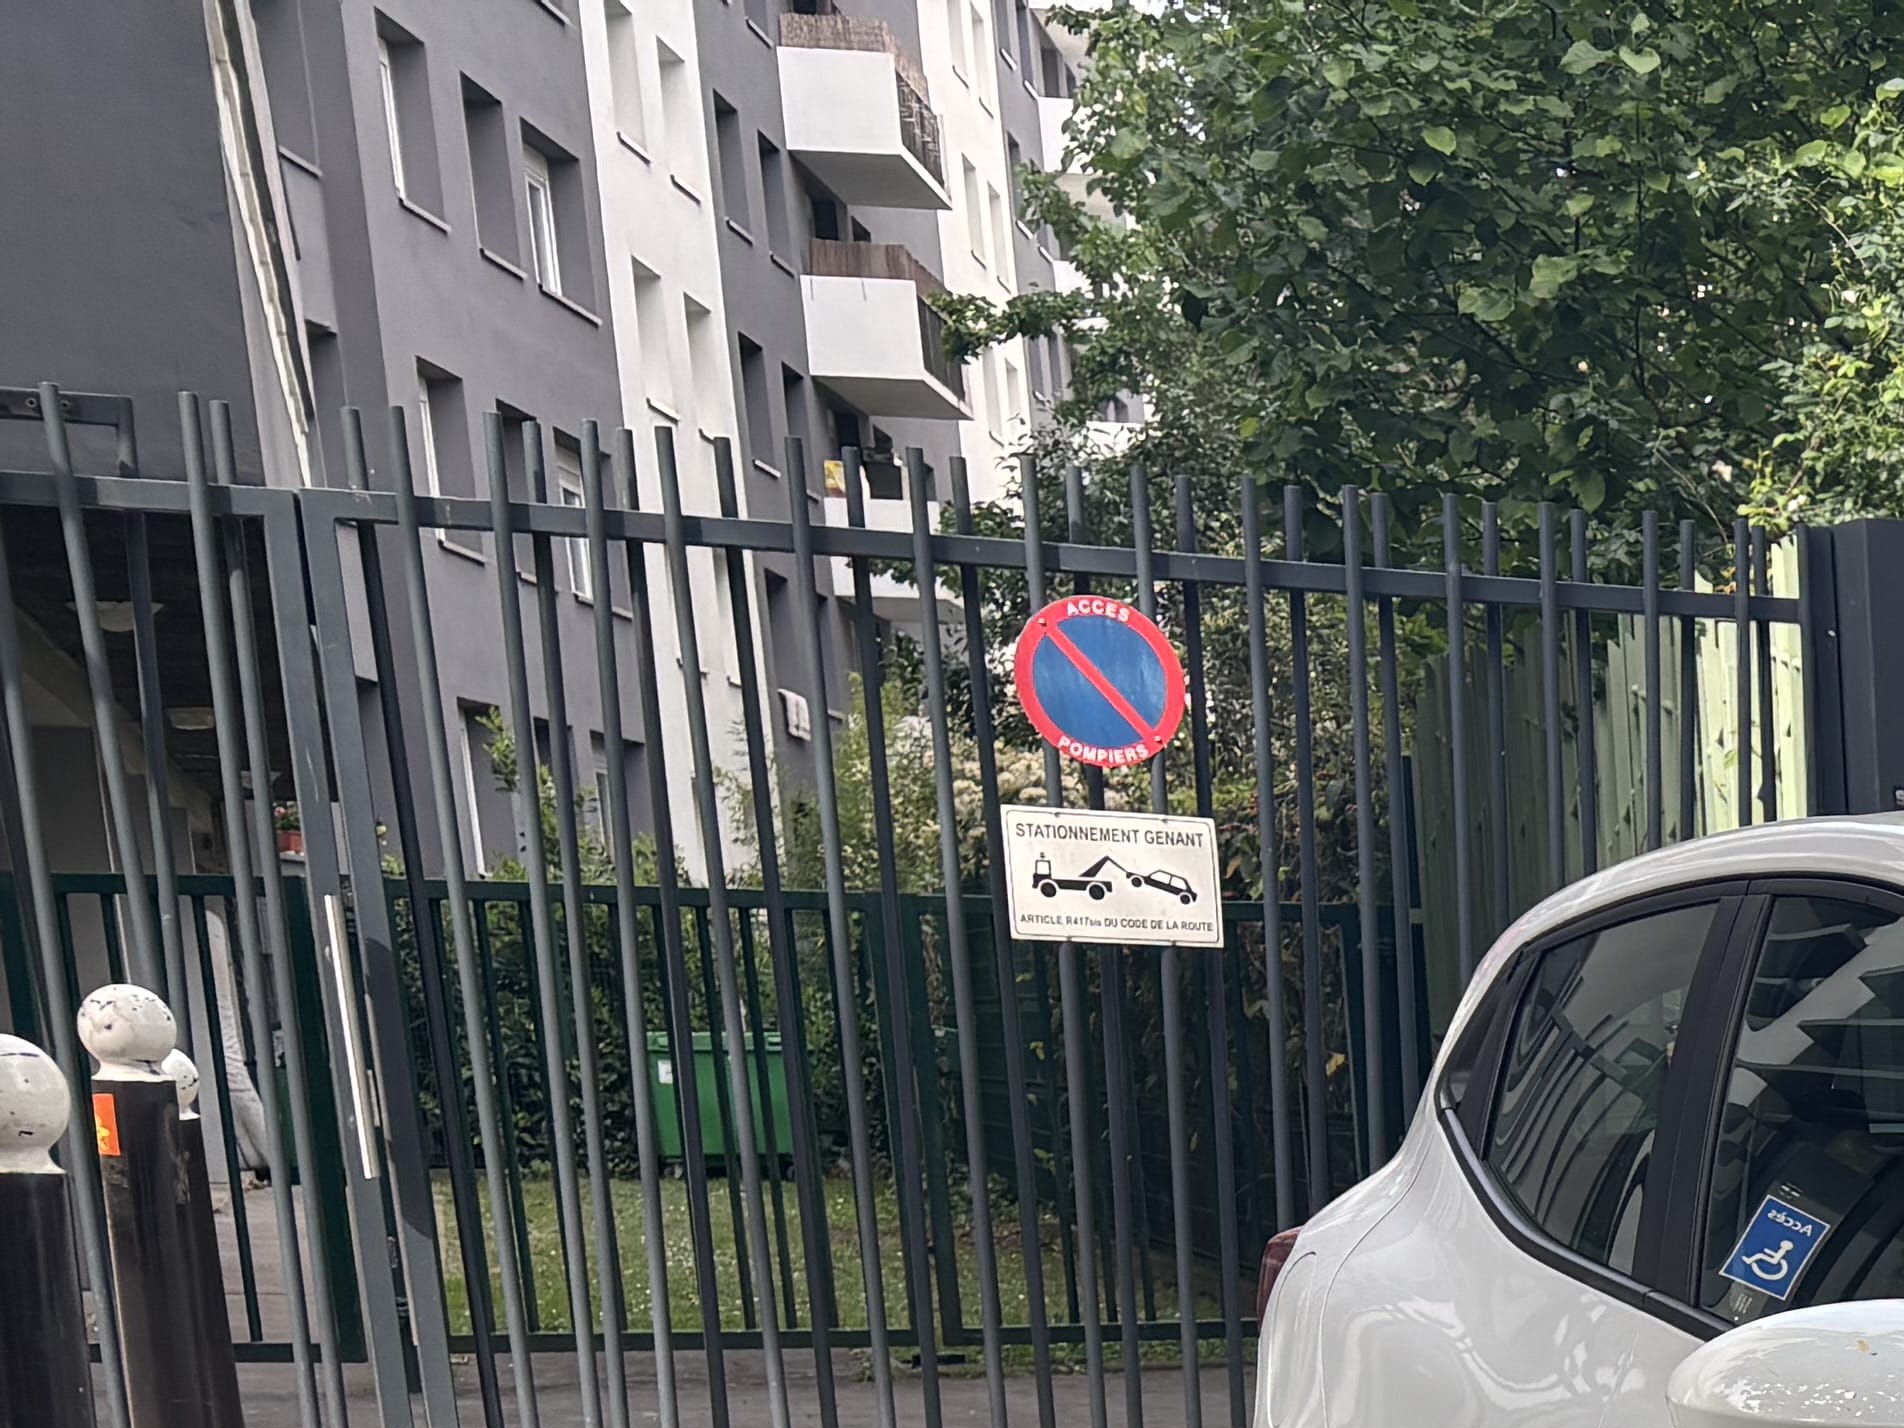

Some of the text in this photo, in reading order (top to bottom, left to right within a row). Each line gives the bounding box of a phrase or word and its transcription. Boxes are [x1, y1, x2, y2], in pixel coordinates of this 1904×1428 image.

[1067, 599, 1130, 623] ACCES
[1058, 735, 1149, 763] POMPIERS
[1015, 823, 1204, 848] STATIONNEMENT GENANT
[1020, 914, 1062, 925] ARTICLE
[1104, 918, 1118, 928] DU
[1120, 918, 1148, 929] CODE
[1150, 919, 1163, 930] DE
[1166, 920, 1179, 930] LA
[1181, 921, 1213, 932] ROUTE
